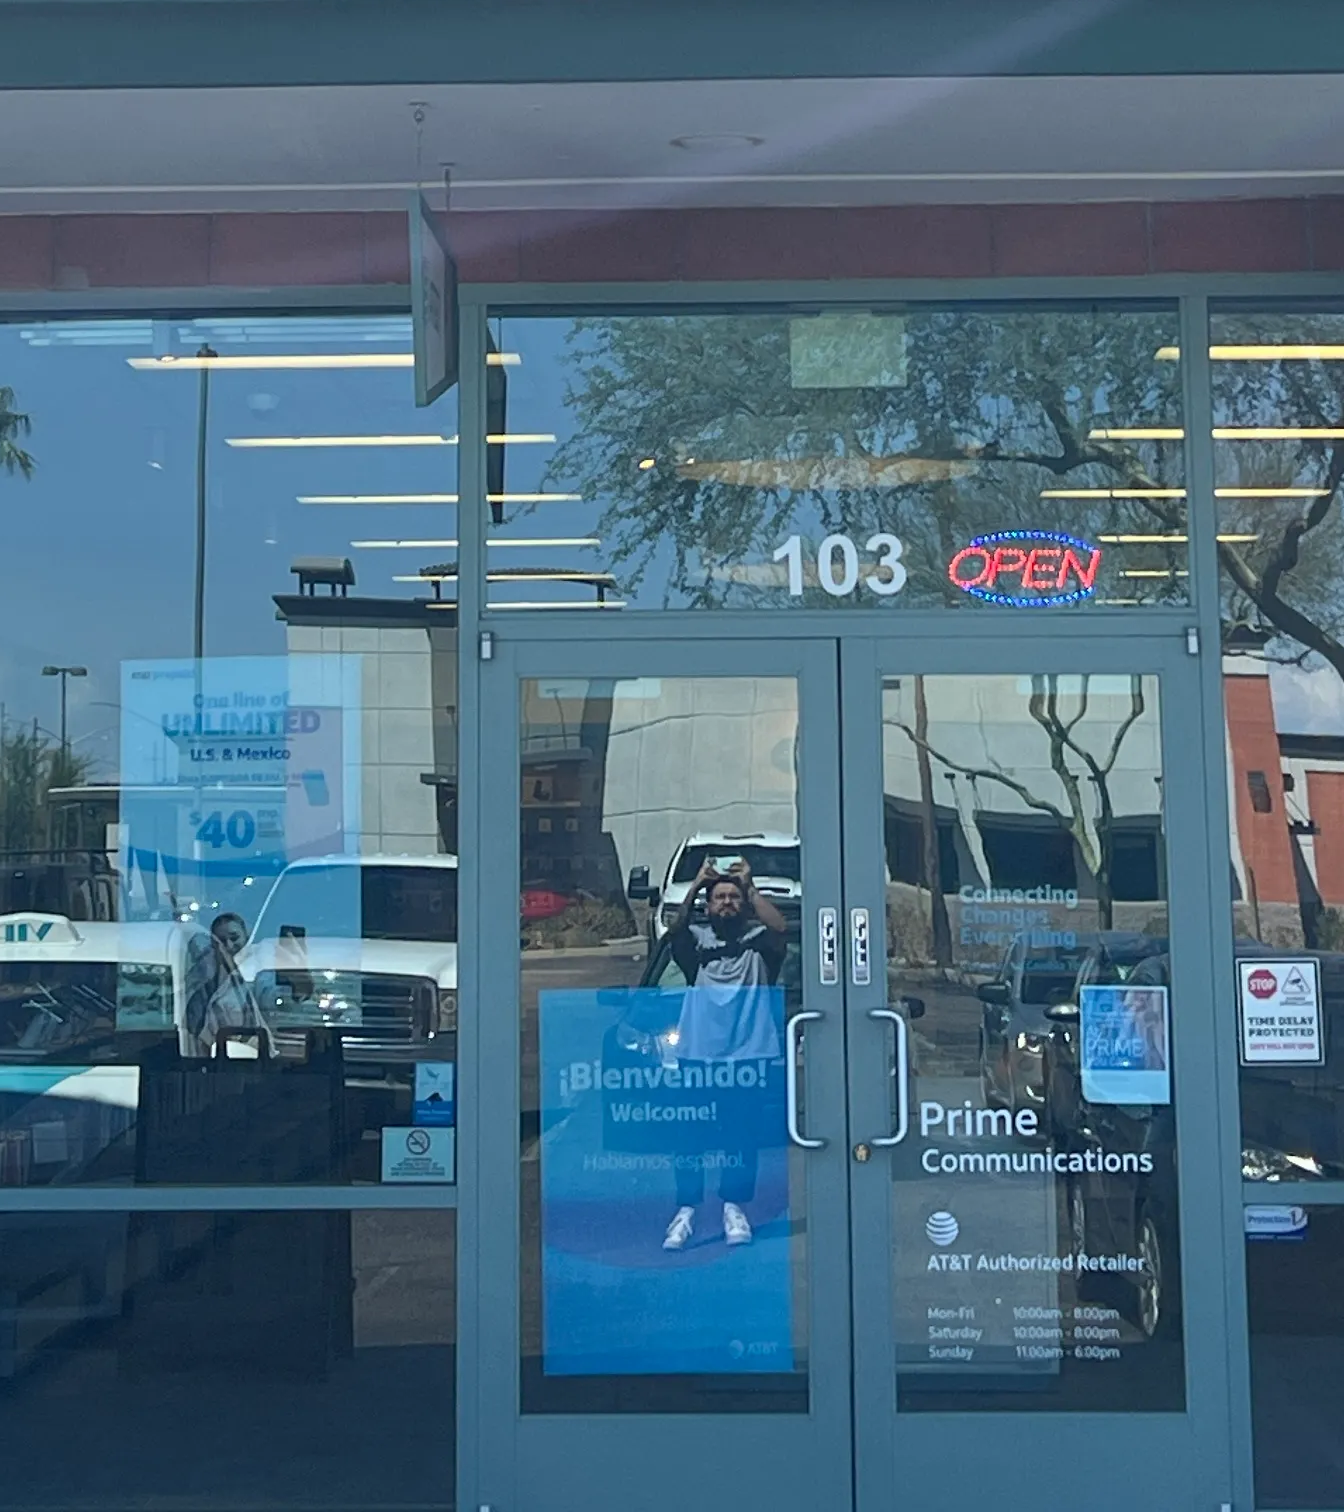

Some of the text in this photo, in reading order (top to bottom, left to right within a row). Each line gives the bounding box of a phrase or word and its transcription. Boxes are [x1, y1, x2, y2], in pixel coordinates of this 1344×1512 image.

[772, 533, 907, 597] 103
[948, 547, 1102, 590] OPEN
[233, 691, 267, 707] line
[270, 690, 291, 707] of
[161, 709, 321, 738] UNLIMITED
[190, 745, 292, 763] U.S. & Mexico
[189, 810, 257, 849] $40
[959, 883, 1078, 909] Connecting
[960, 904, 1050, 926] Changes
[823, 914, 835, 966] PULL
[855, 914, 867, 966] PULL
[1249, 978, 1276, 991] STOP
[1247, 1016, 1314, 1026] TIME DELAY
[1248, 1027, 1315, 1037] PROTECTED
[1086, 1038, 1145, 1058] PRIME
[559, 1059, 767, 1097] ¡Bienvenido!
[610, 1101, 718, 1123] Welcome!
[920, 1100, 1039, 1137] Prime
[582, 1149, 746, 1173] Hablamos español.
[921, 1147, 1154, 1174] Communications
[927, 1253, 1147, 1272] AT&T Authorized Retailer
[927, 1307, 976, 1321] Mon-Fri
[928, 1325, 984, 1342] Saturday
[928, 1345, 975, 1361] Sunday
